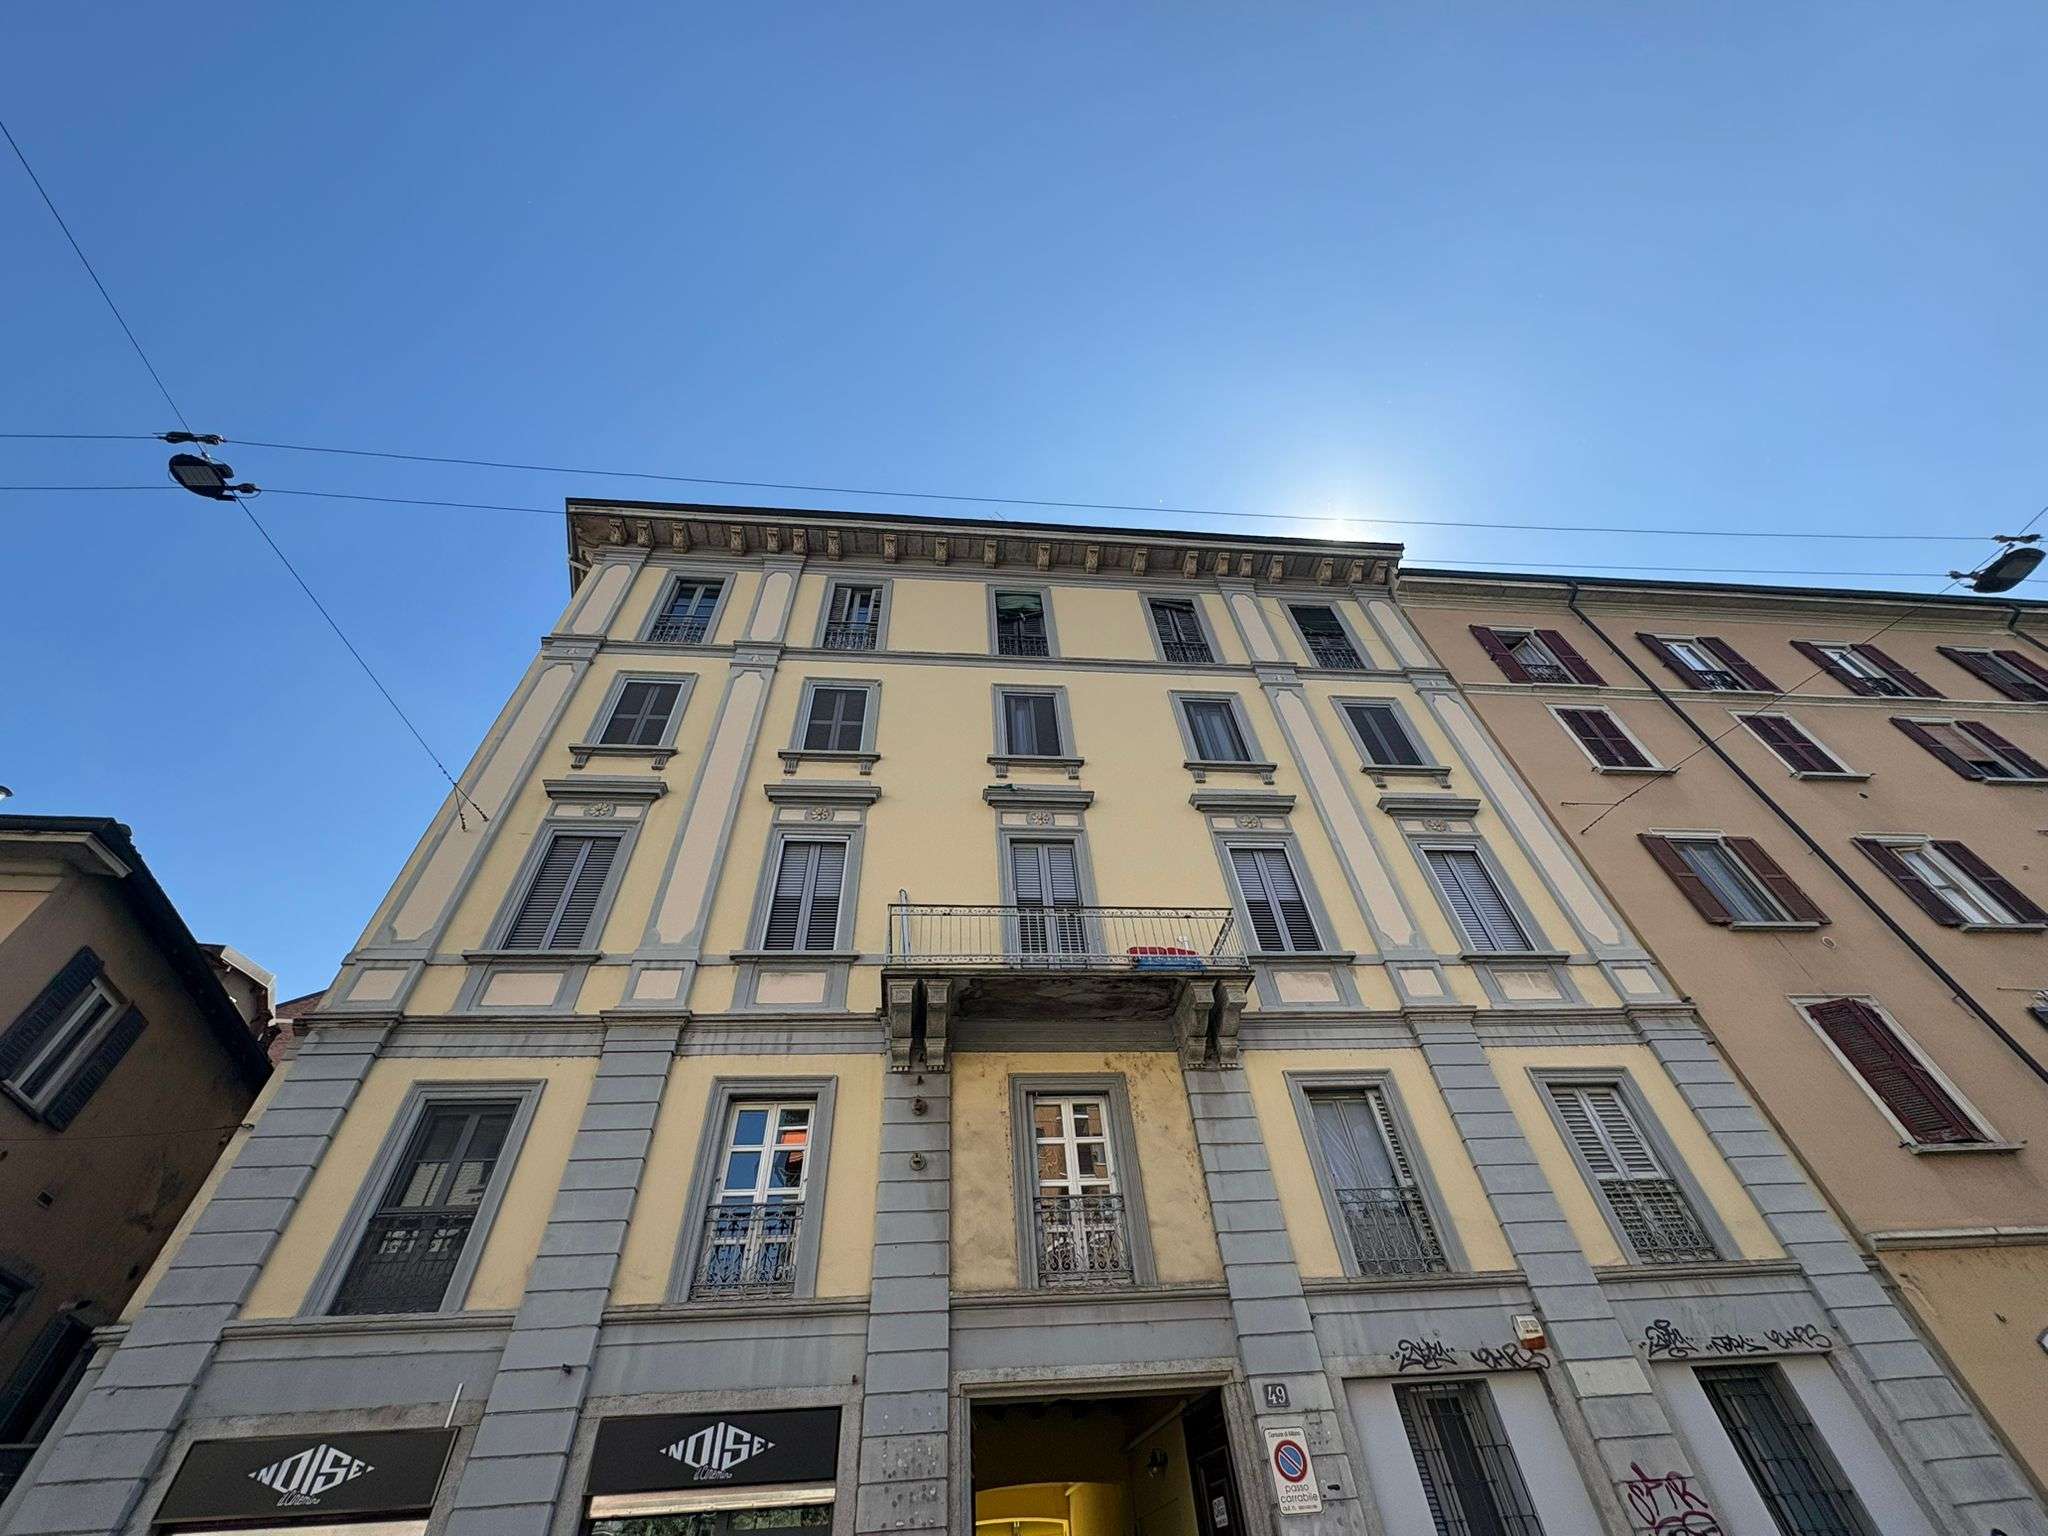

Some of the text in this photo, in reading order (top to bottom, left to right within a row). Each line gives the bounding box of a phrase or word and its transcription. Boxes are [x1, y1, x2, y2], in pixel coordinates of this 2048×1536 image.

[1268, 1386, 1286, 1404] 49
[668, 1421, 766, 1471] NOISE
[256, 1444, 366, 1496] NOISE
[1280, 1493, 1319, 1503] carrabile
[1285, 1484, 1309, 1494] passo
